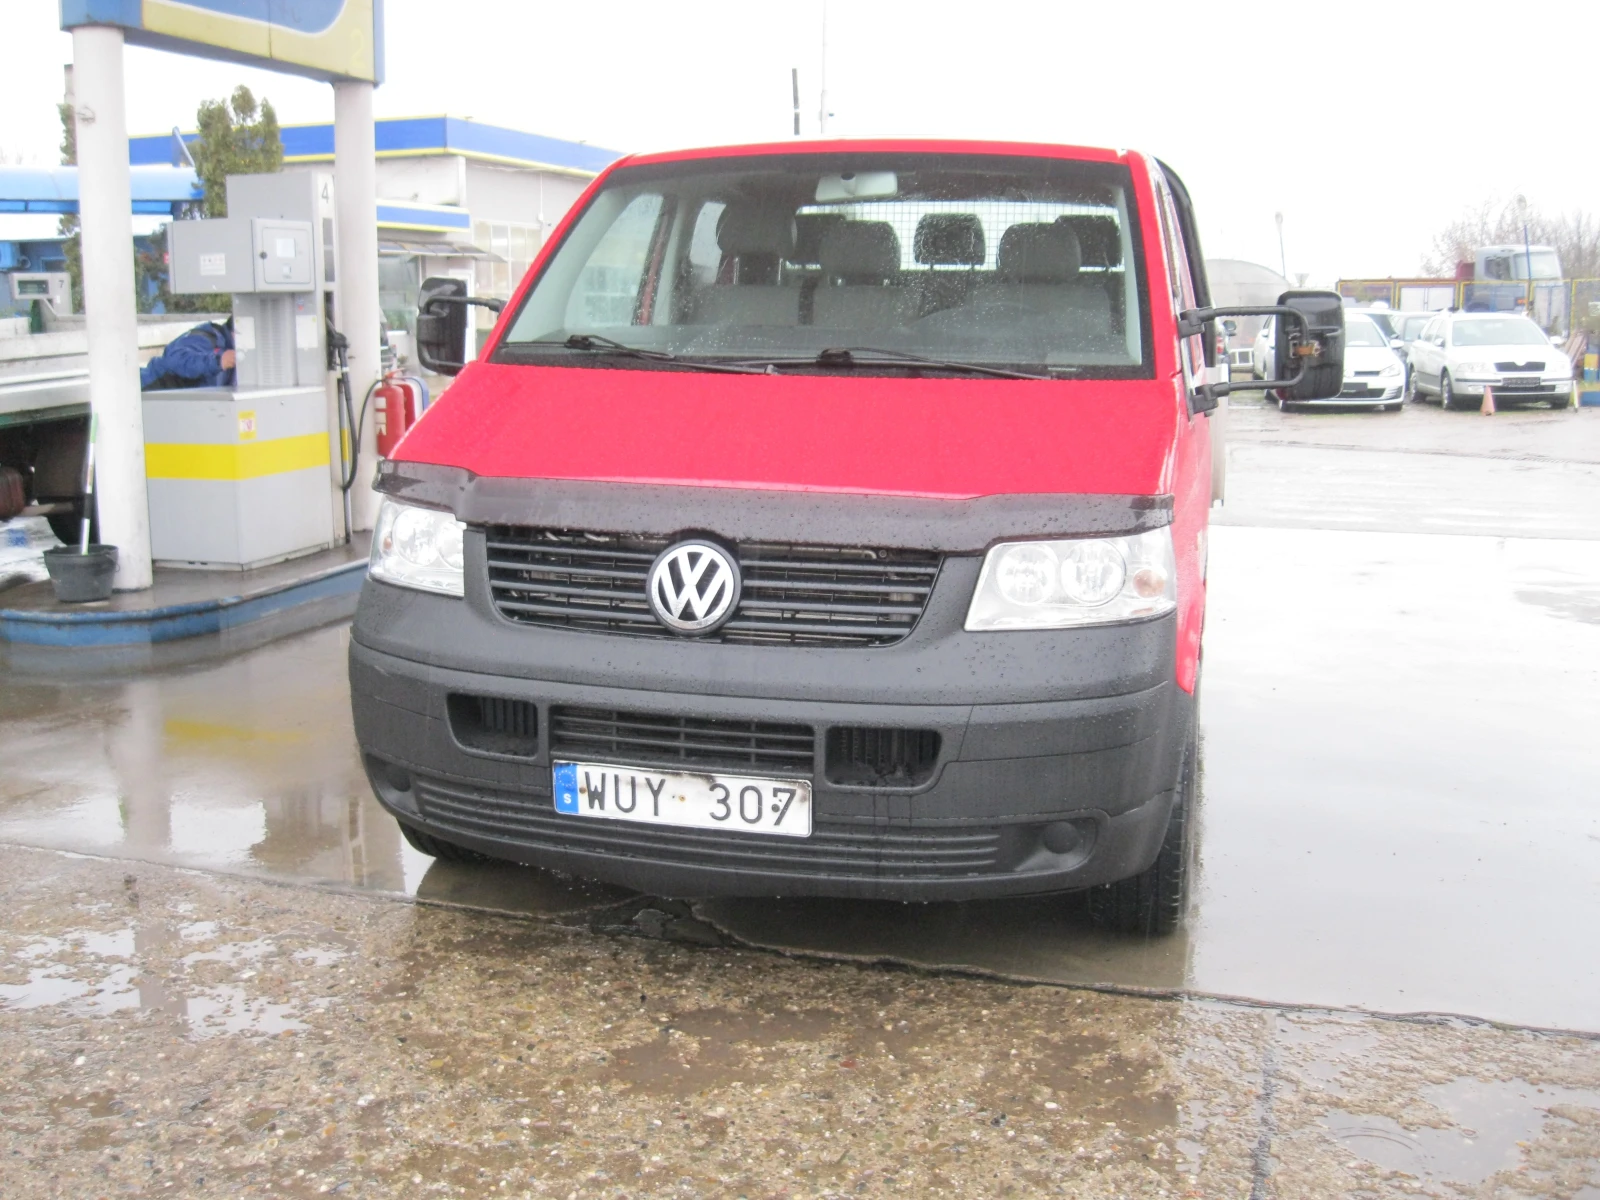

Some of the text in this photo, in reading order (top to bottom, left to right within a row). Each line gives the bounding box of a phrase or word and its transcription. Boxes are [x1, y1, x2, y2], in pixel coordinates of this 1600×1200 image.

[350, 28, 366, 68] 2
[321, 182, 329, 204] 4
[58, 279, 65, 289] 7
[651, 544, 734, 629] VW
[563, 793, 572, 804] S
[584, 771, 797, 826] WUY 307
